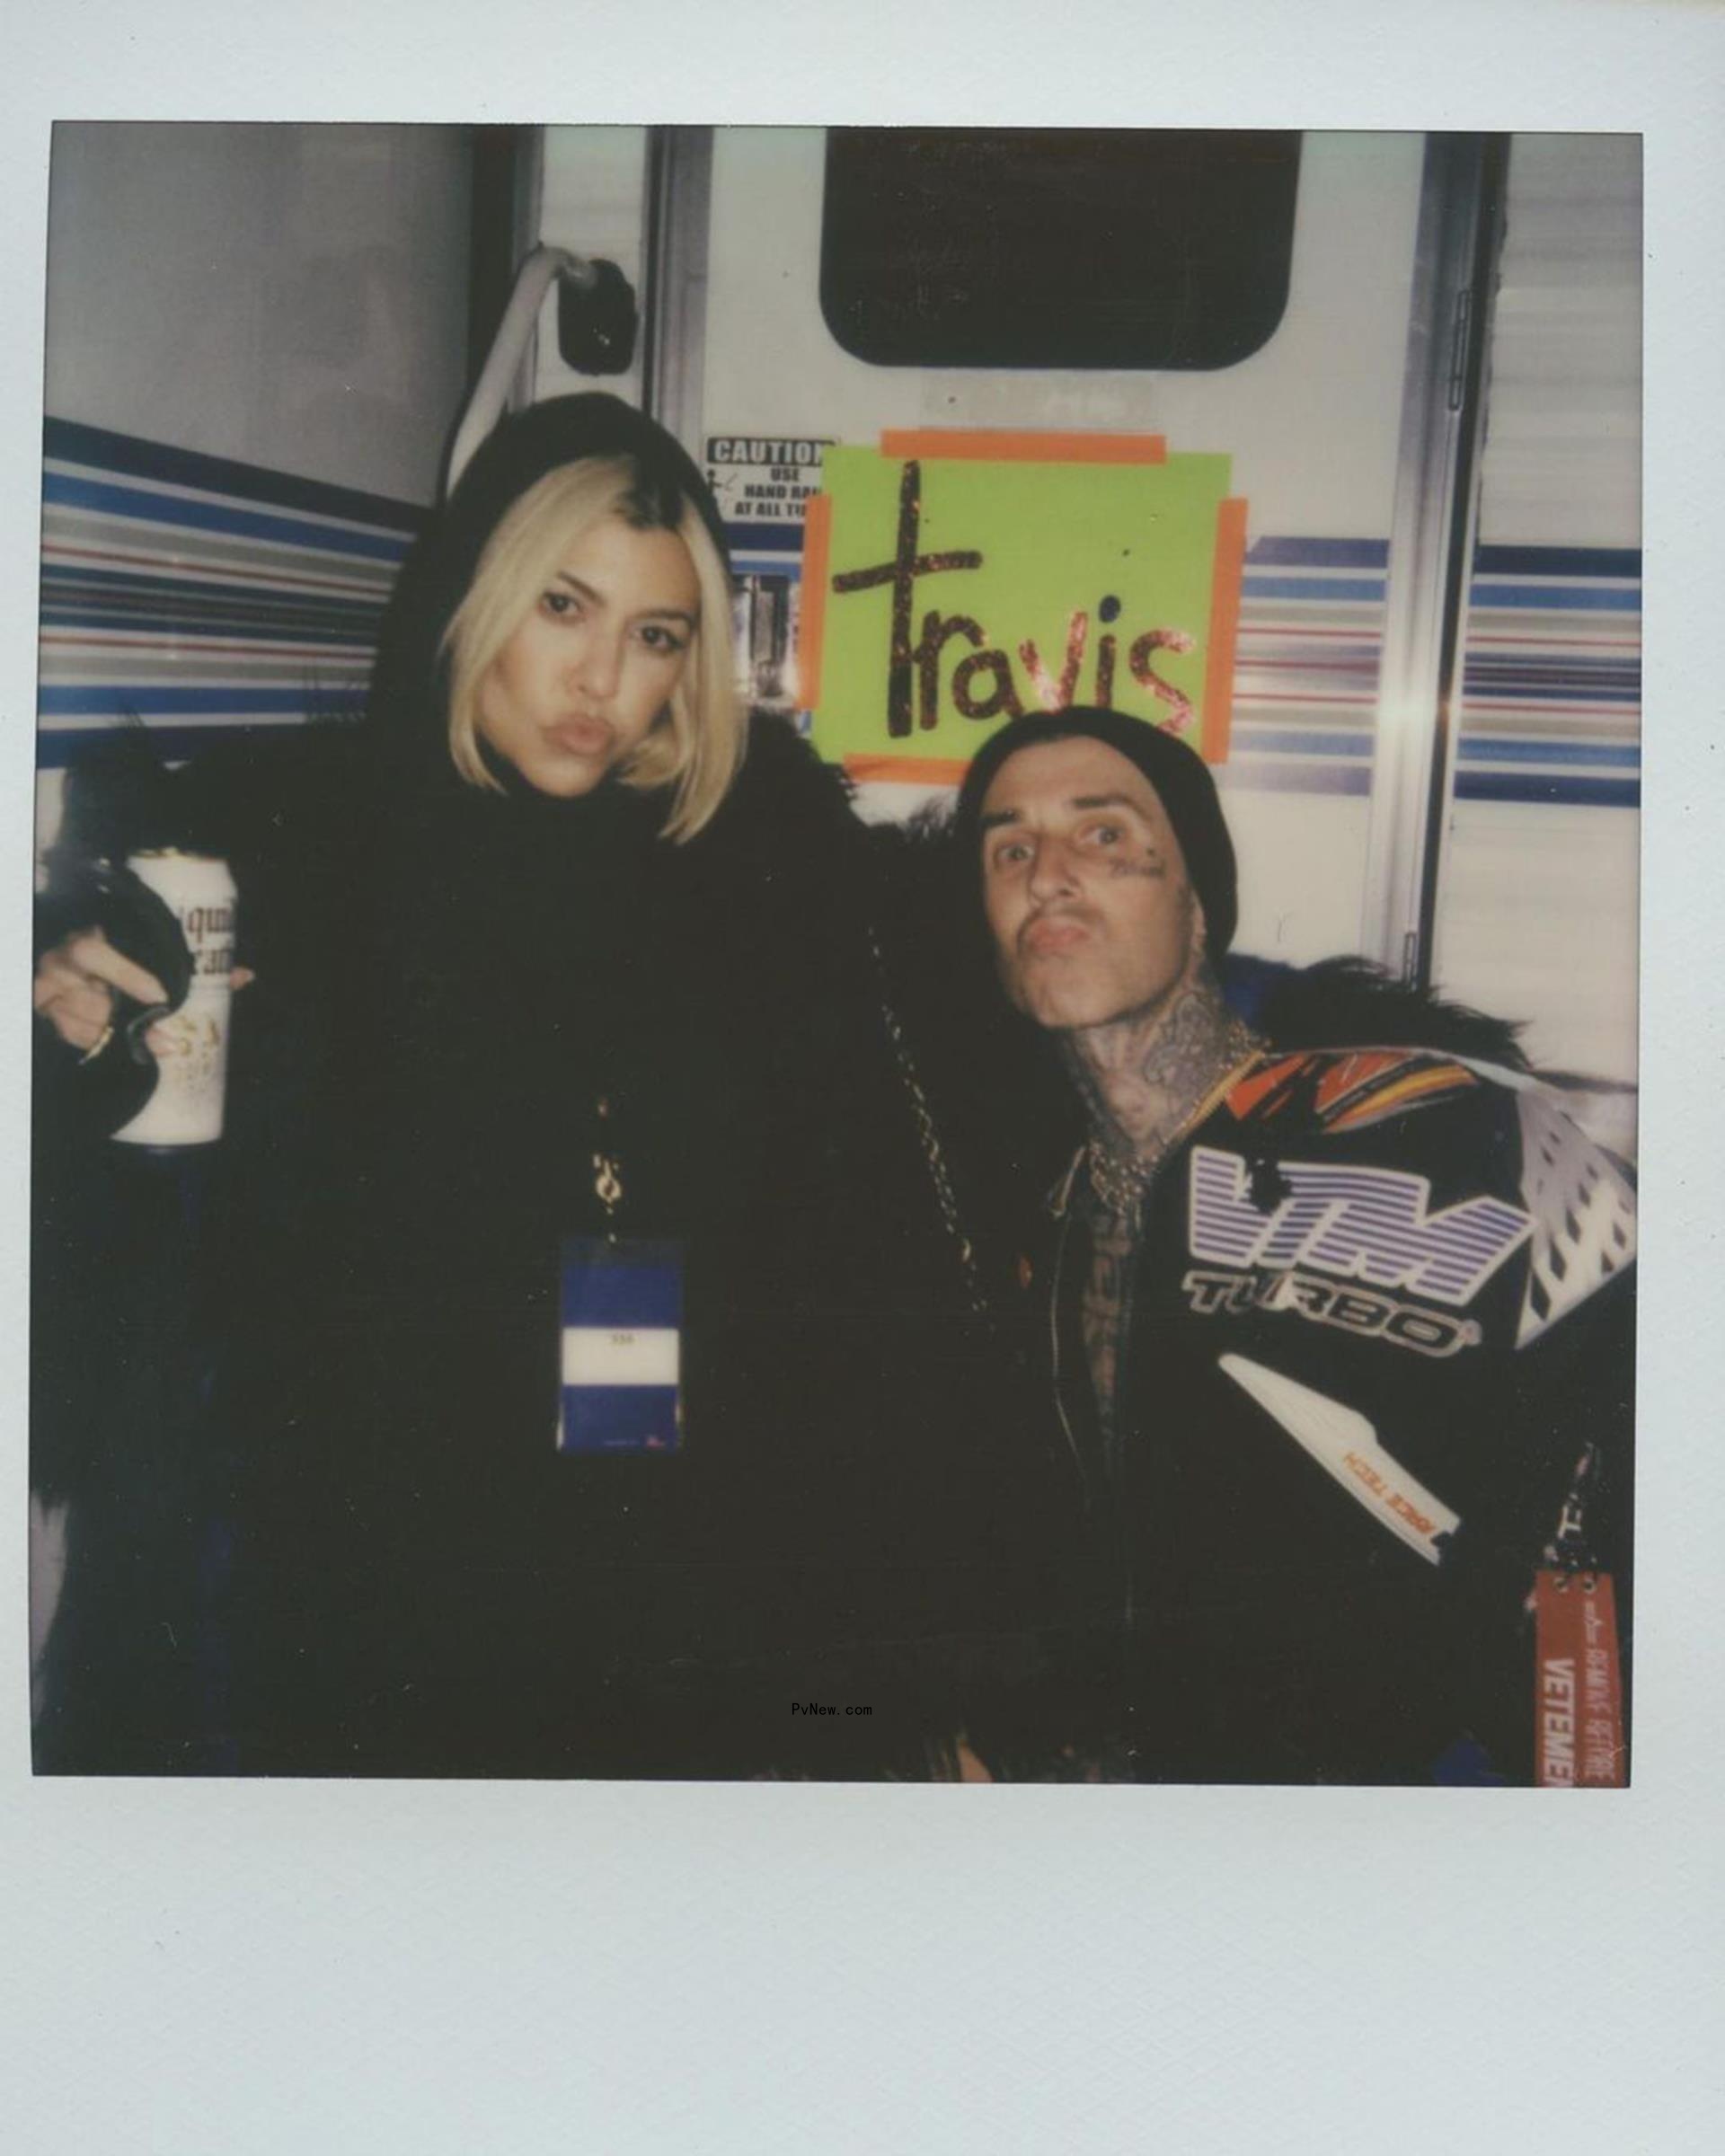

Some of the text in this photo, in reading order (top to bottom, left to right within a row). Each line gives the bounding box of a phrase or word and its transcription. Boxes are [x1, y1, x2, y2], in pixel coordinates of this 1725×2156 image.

[771, 467, 800, 482] USE
[745, 484, 787, 499] HAND
[735, 501, 752, 515] AT
[756, 502, 781, 516] ALL
